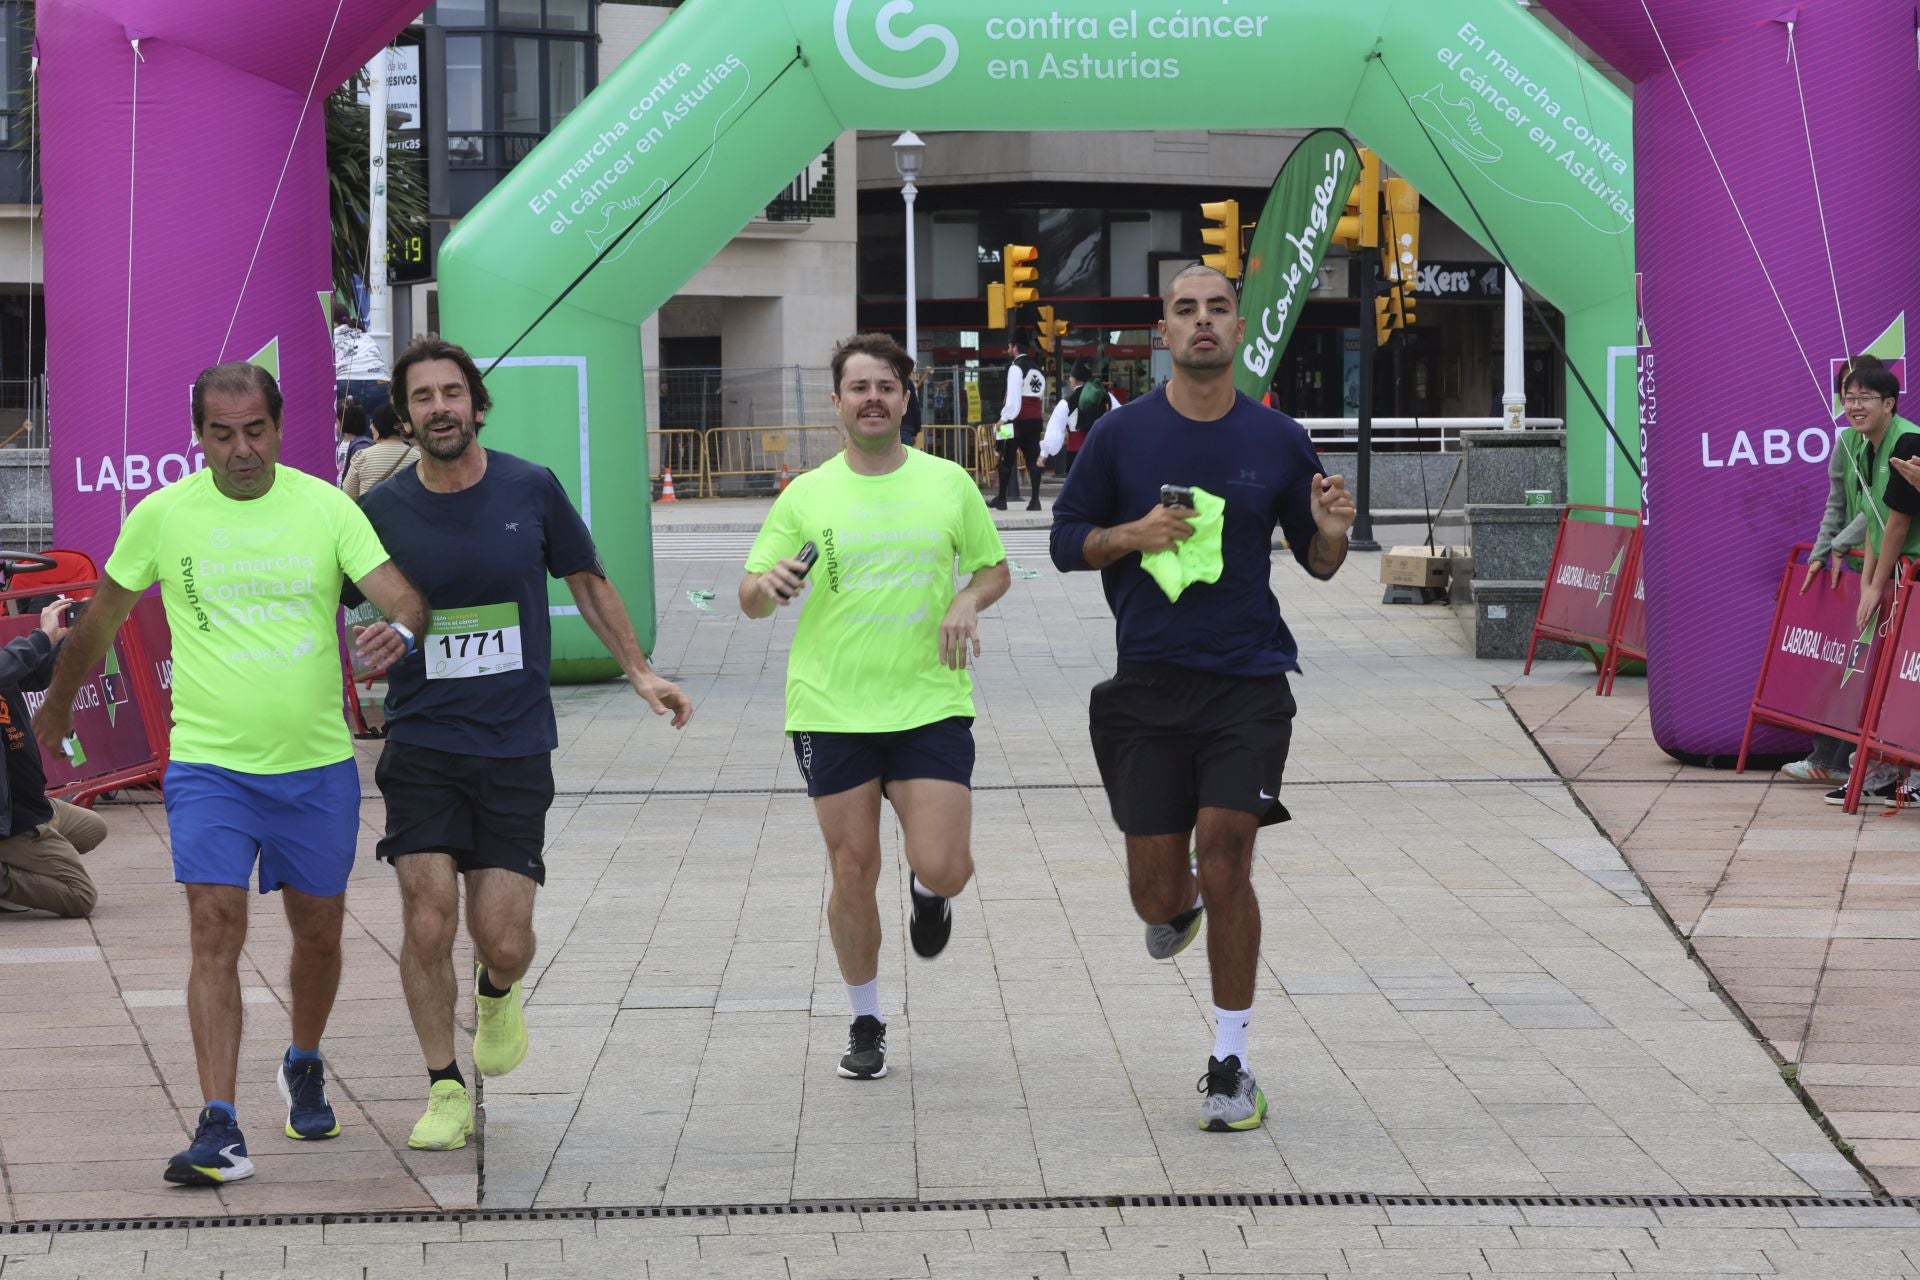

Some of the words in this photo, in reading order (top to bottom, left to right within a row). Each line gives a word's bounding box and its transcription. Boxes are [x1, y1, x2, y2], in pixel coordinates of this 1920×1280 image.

[986, 10, 1098, 40] contra
[1108, 9, 1137, 39] el
[1147, 9, 1269, 39] cáncer
[987, 58, 1029, 79] en
[1038, 51, 1180, 80] Asturias
[1456, 21, 1486, 52] En
[1484, 49, 1561, 118] marcha
[1562, 115, 1628, 175] contra
[527, 188, 558, 216] En
[556, 120, 630, 190] marcha
[628, 61, 692, 122] contra
[550, 210, 573, 235] el
[570, 150, 636, 215] cáncer
[635, 126, 664, 153] en
[661, 53, 741, 130] Asturias
[1436, 47, 1463, 70] el
[1459, 66, 1530, 128] cáncer
[1528, 126, 1557, 154] en
[1555, 149, 1634, 224] Asturias
[1646, 354, 1658, 425] kutxa
[1636, 354, 1651, 526] LABORAL
[1701, 426, 1850, 469] LABO
[838, 529, 863, 546] En
[199, 559, 226, 577] En
[231, 553, 314, 574] marcha
[822, 528, 840, 594] ASTURIAS
[841, 546, 915, 568] contra
[918, 544, 938, 564] el
[202, 577, 286, 602] contra
[291, 573, 314, 595] el
[844, 568, 936, 592] cáncer
[1557, 564, 1585, 588] LABORAL
[210, 599, 313, 628] cáncer
[439, 629, 504, 659] 1771
[1781, 625, 1823, 660] LABORAL
[1820, 636, 1846, 665] kutxa
